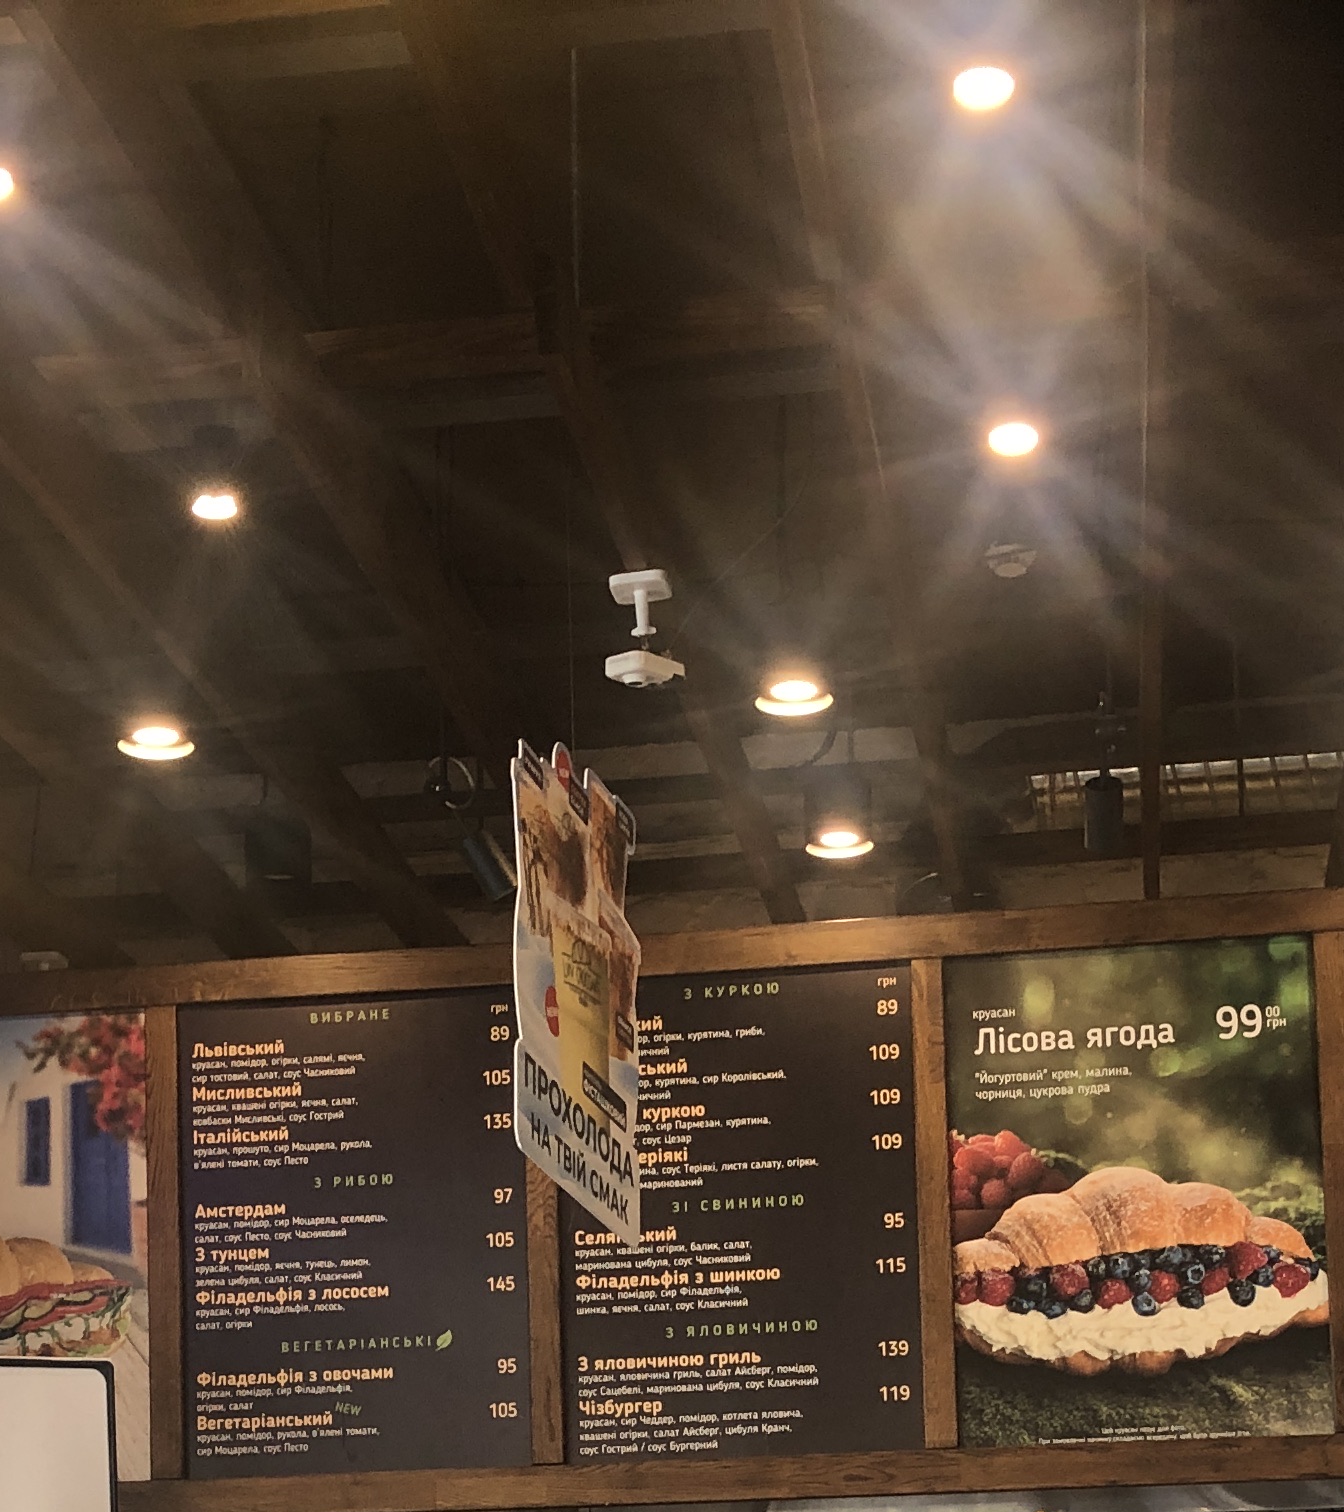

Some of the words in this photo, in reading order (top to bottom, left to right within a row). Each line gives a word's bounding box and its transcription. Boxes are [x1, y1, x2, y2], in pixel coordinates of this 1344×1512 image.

[684, 988, 692, 999] З
[705, 982, 778, 998] КУРКОЮ
[310, 1009, 390, 1024] ВИБРАНЕ
[973, 1009, 1016, 1022] круасан
[1266, 1019, 1287, 1030] грн
[974, 1027, 1075, 1055] Лісова
[1087, 1024, 1175, 1051] ягода
[1216, 1004, 1263, 1040] 99
[1265, 1006, 1281, 1018] 00
[192, 1040, 284, 1058] Львівський
[490, 1026, 509, 1041] 89
[1052, 1069, 1082, 1081] крем,
[1085, 1067, 1133, 1078] малина,
[193, 1082, 301, 1101] Мисливський
[483, 1070, 511, 1087] 105
[976, 1088, 1026, 1102] чорниця,
[1029, 1086, 1074, 1098] цукрова
[1078, 1084, 1111, 1097] пудра
[194, 1126, 288, 1144] Італійський
[484, 1114, 512, 1131] 135
[524, 1052, 633, 1187] ПРОХОЛОДА
[531, 1112, 552, 1157] НА
[554, 1134, 587, 1189] ТВІЙ
[590, 1170, 629, 1227] СМАК
[314, 1177, 322, 1188] З
[334, 1173, 393, 1187] РИБОЮ
[195, 1204, 285, 1220] Амстердам
[494, 1188, 512, 1203] 97
[672, 1201, 687, 1213] ЗІ
[701, 1194, 804, 1211] СВИНИНОЮ
[884, 1212, 904, 1228] 95
[576, 1270, 688, 1289] Філадельфія
[696, 1272, 703, 1283] з
[710, 1268, 780, 1283] шинкою
[876, 1257, 906, 1273] 115
[196, 1286, 302, 1305] Філадельфія
[308, 1289, 316, 1300] з
[322, 1286, 388, 1300] лососем
[487, 1276, 515, 1291] 145
[661, 1288, 677, 1298] сир
[666, 1327, 673, 1338] З
[687, 1320, 817, 1337] ЯЛОВИЧИНОЮ
[282, 1334, 433, 1353] ВЕГЕТАРІАНСЬКІ
[578, 1357, 588, 1371] З
[595, 1355, 704, 1370] яловичиною
[710, 1352, 761, 1368] гриль
[878, 1341, 908, 1356] 139
[336, 1402, 361, 1415] NEW
[580, 1399, 662, 1417] Чізбургер
[880, 1385, 910, 1401] 119
[198, 1413, 332, 1432] Вегетаріанський
[490, 1402, 517, 1418] 105
